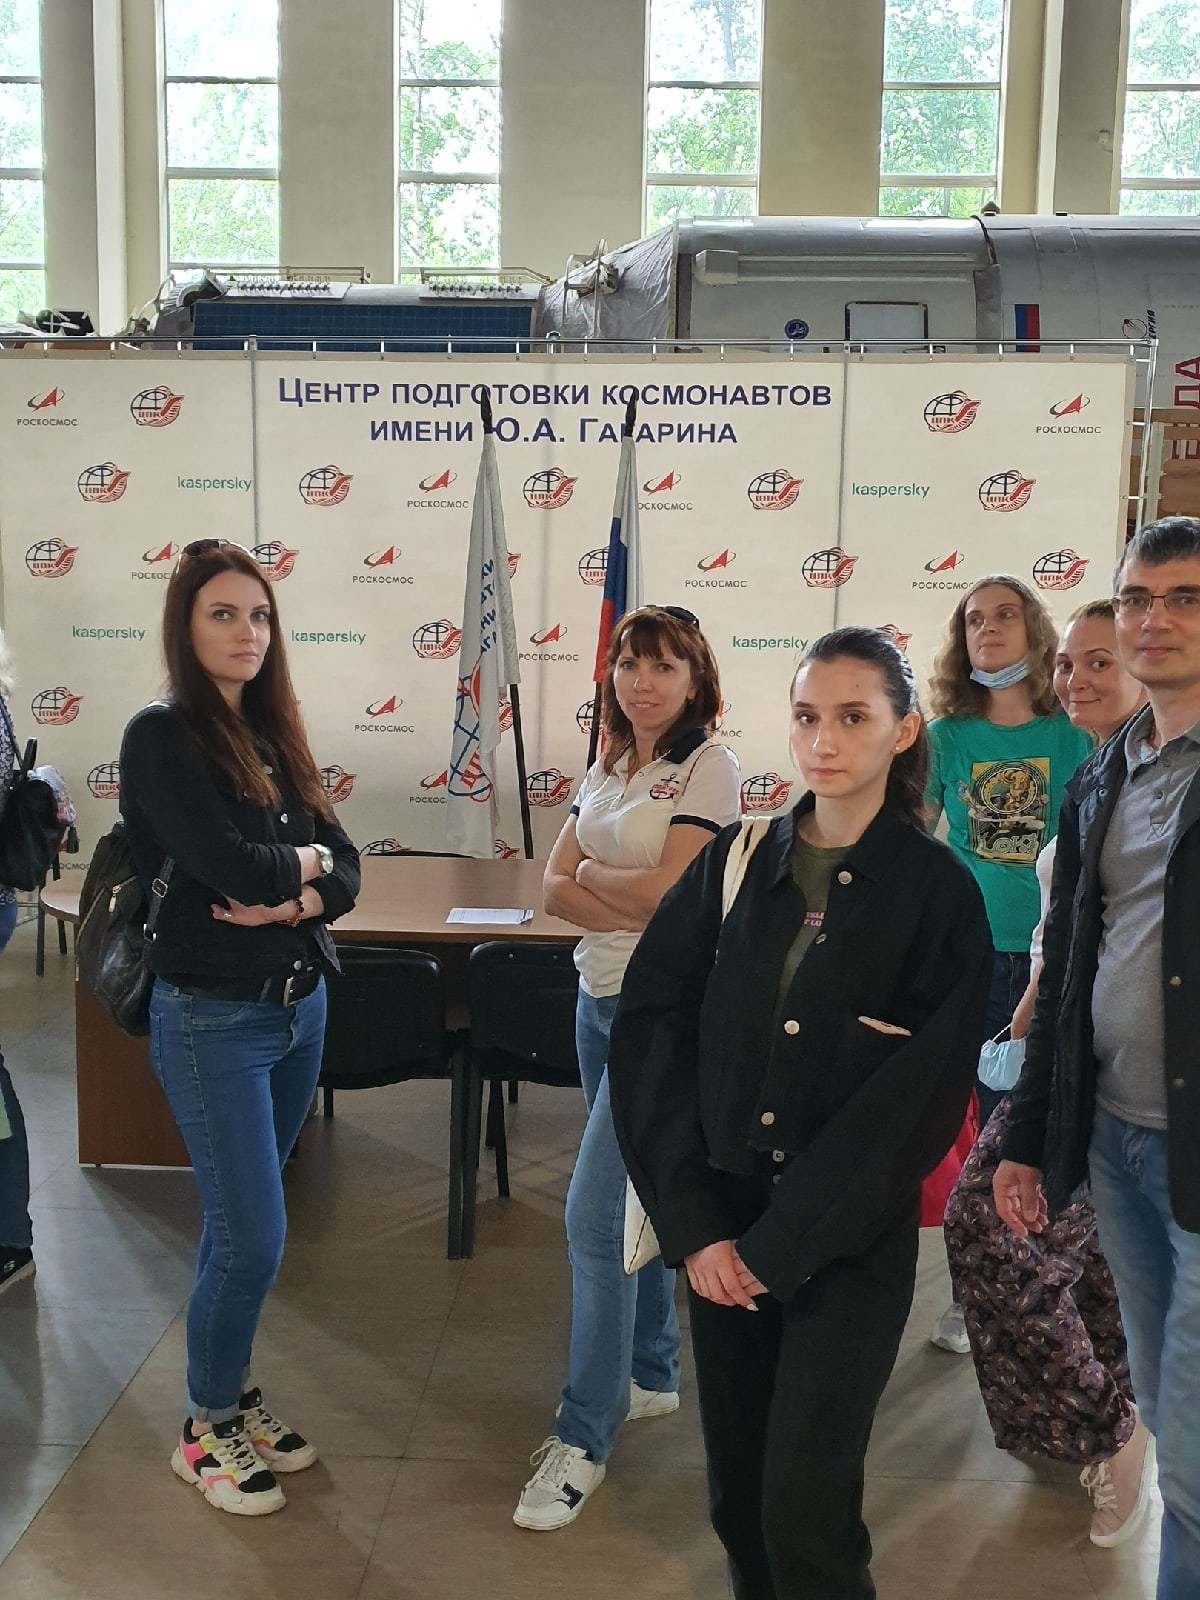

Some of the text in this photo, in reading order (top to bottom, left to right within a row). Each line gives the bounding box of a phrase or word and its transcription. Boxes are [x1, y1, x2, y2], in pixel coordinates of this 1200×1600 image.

[279, 377, 832, 408] ЦЕНТР ПОДГОТОВКИ КОСМОНАВТОВ
[16, 418, 78, 427] РОСКОСМОС
[370, 421, 473, 442] ИМЕНИ
[579, 418, 738, 443] ГААРИНА
[1035, 425, 1102, 434] РОСКОСМОС
[177, 475, 252, 492] kaspersky
[852, 482, 931, 499] kaspersky
[407, 500, 469, 509] РОСКОСМОС
[638, 502, 694, 511] ОСКОСМОС
[131, 571, 171, 580] РОСКОС
[352, 575, 414, 585] РОСКОСМОС
[685, 579, 748, 588] РОСКОСМОС
[72, 625, 146, 642] kaspersky
[291, 629, 367, 646] kaspersky
[732, 635, 809, 652] kaspersky
[518, 653, 580, 662] РОСКОСМОС
[354, 724, 415, 734] РОСКОСМОС
[409, 796, 447, 804] РОСКОС
